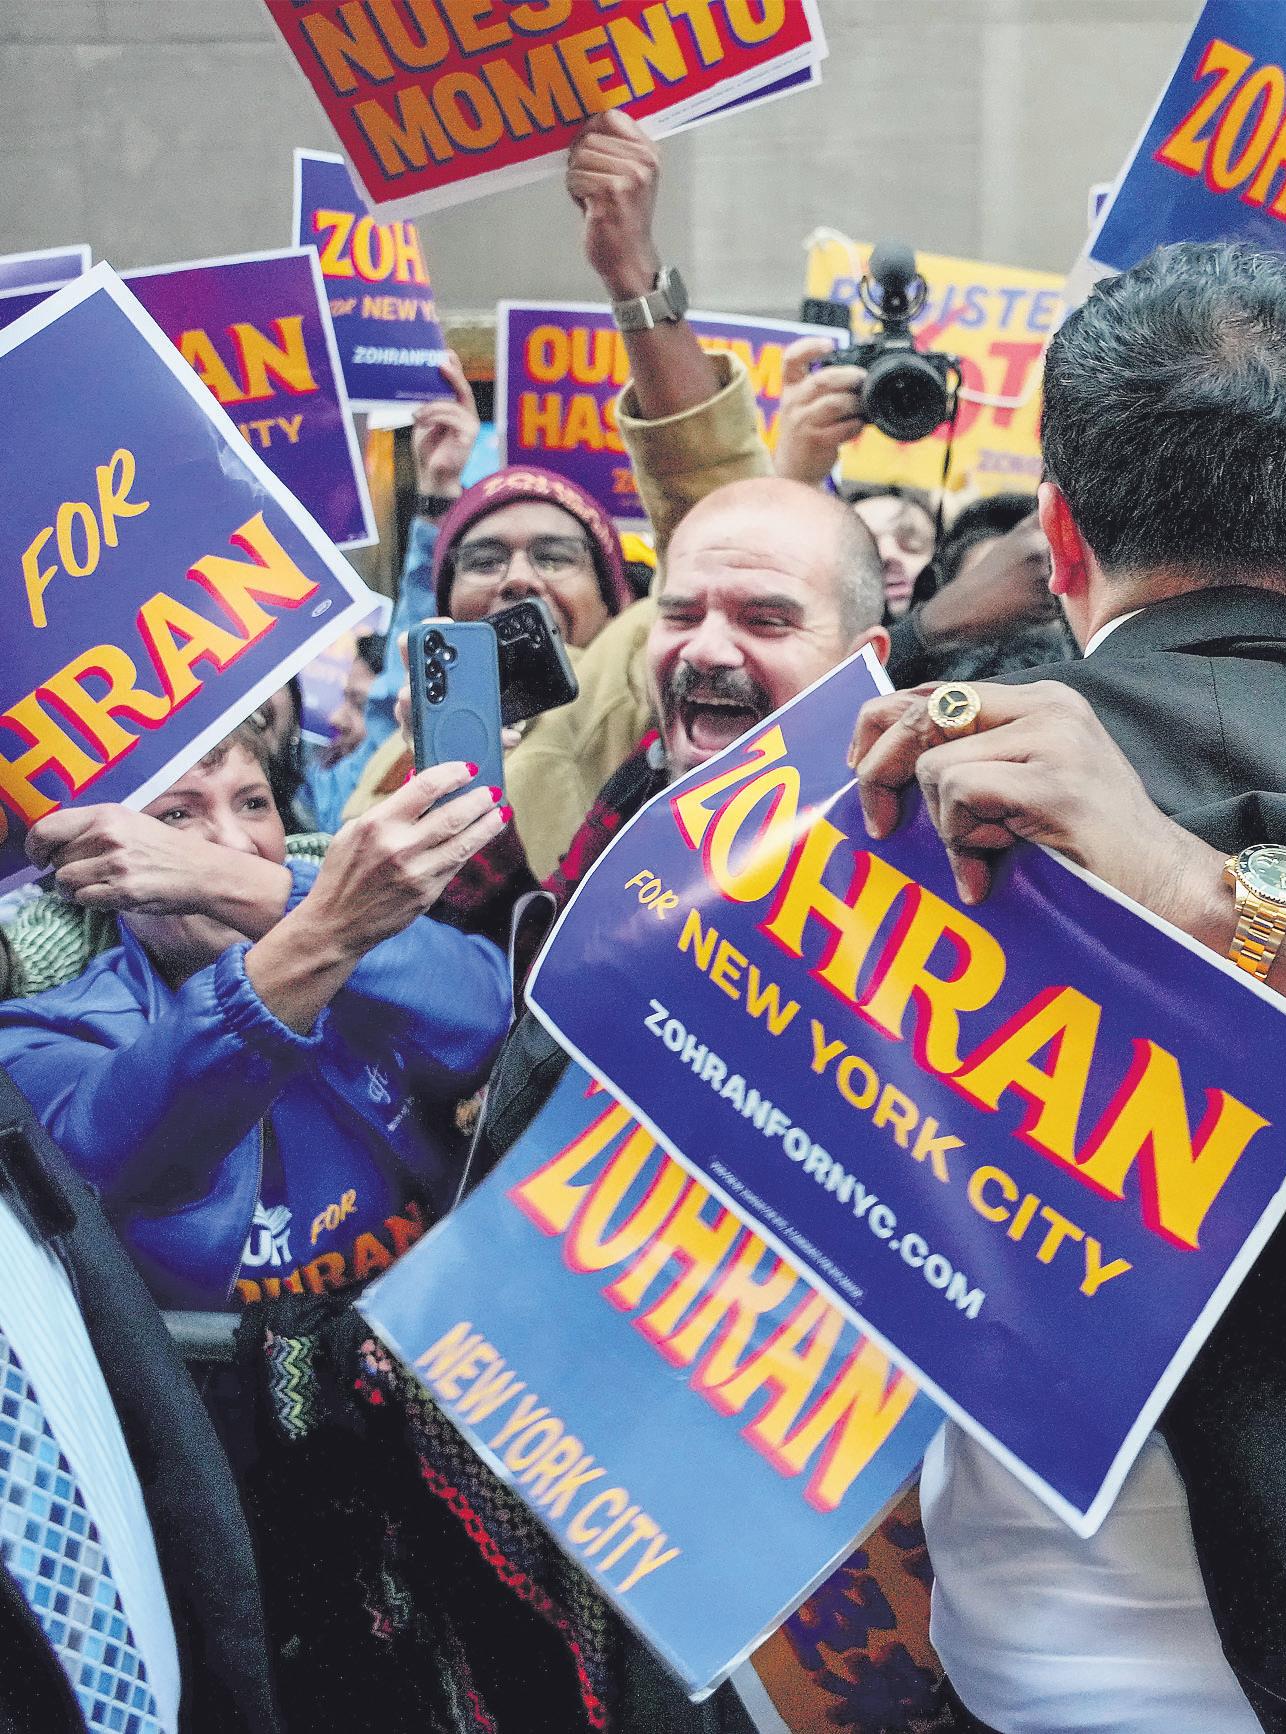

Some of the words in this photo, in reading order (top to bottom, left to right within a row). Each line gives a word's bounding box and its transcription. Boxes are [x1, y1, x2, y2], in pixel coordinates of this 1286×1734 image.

[362, 294, 418, 321] NEW
[0, 511, 320, 832] HRAN
[22, 448, 149, 628] FOR
[624, 870, 679, 920] FOR
[678, 908, 800, 1036] NEW
[810, 1018, 966, 1183] YORK
[967, 1165, 1133, 1296] CITY
[671, 724, 1272, 1252] ZOHRAN
[311, 1189, 358, 1246] FOR
[505, 1078, 920, 1513] ZOHRAN
[643, 999, 986, 1319] ZOHRANFORNYC.COM
[414, 1321, 527, 1424] NEW
[488, 1393, 608, 1519] YORK
[566, 1486, 683, 1594] CITY
